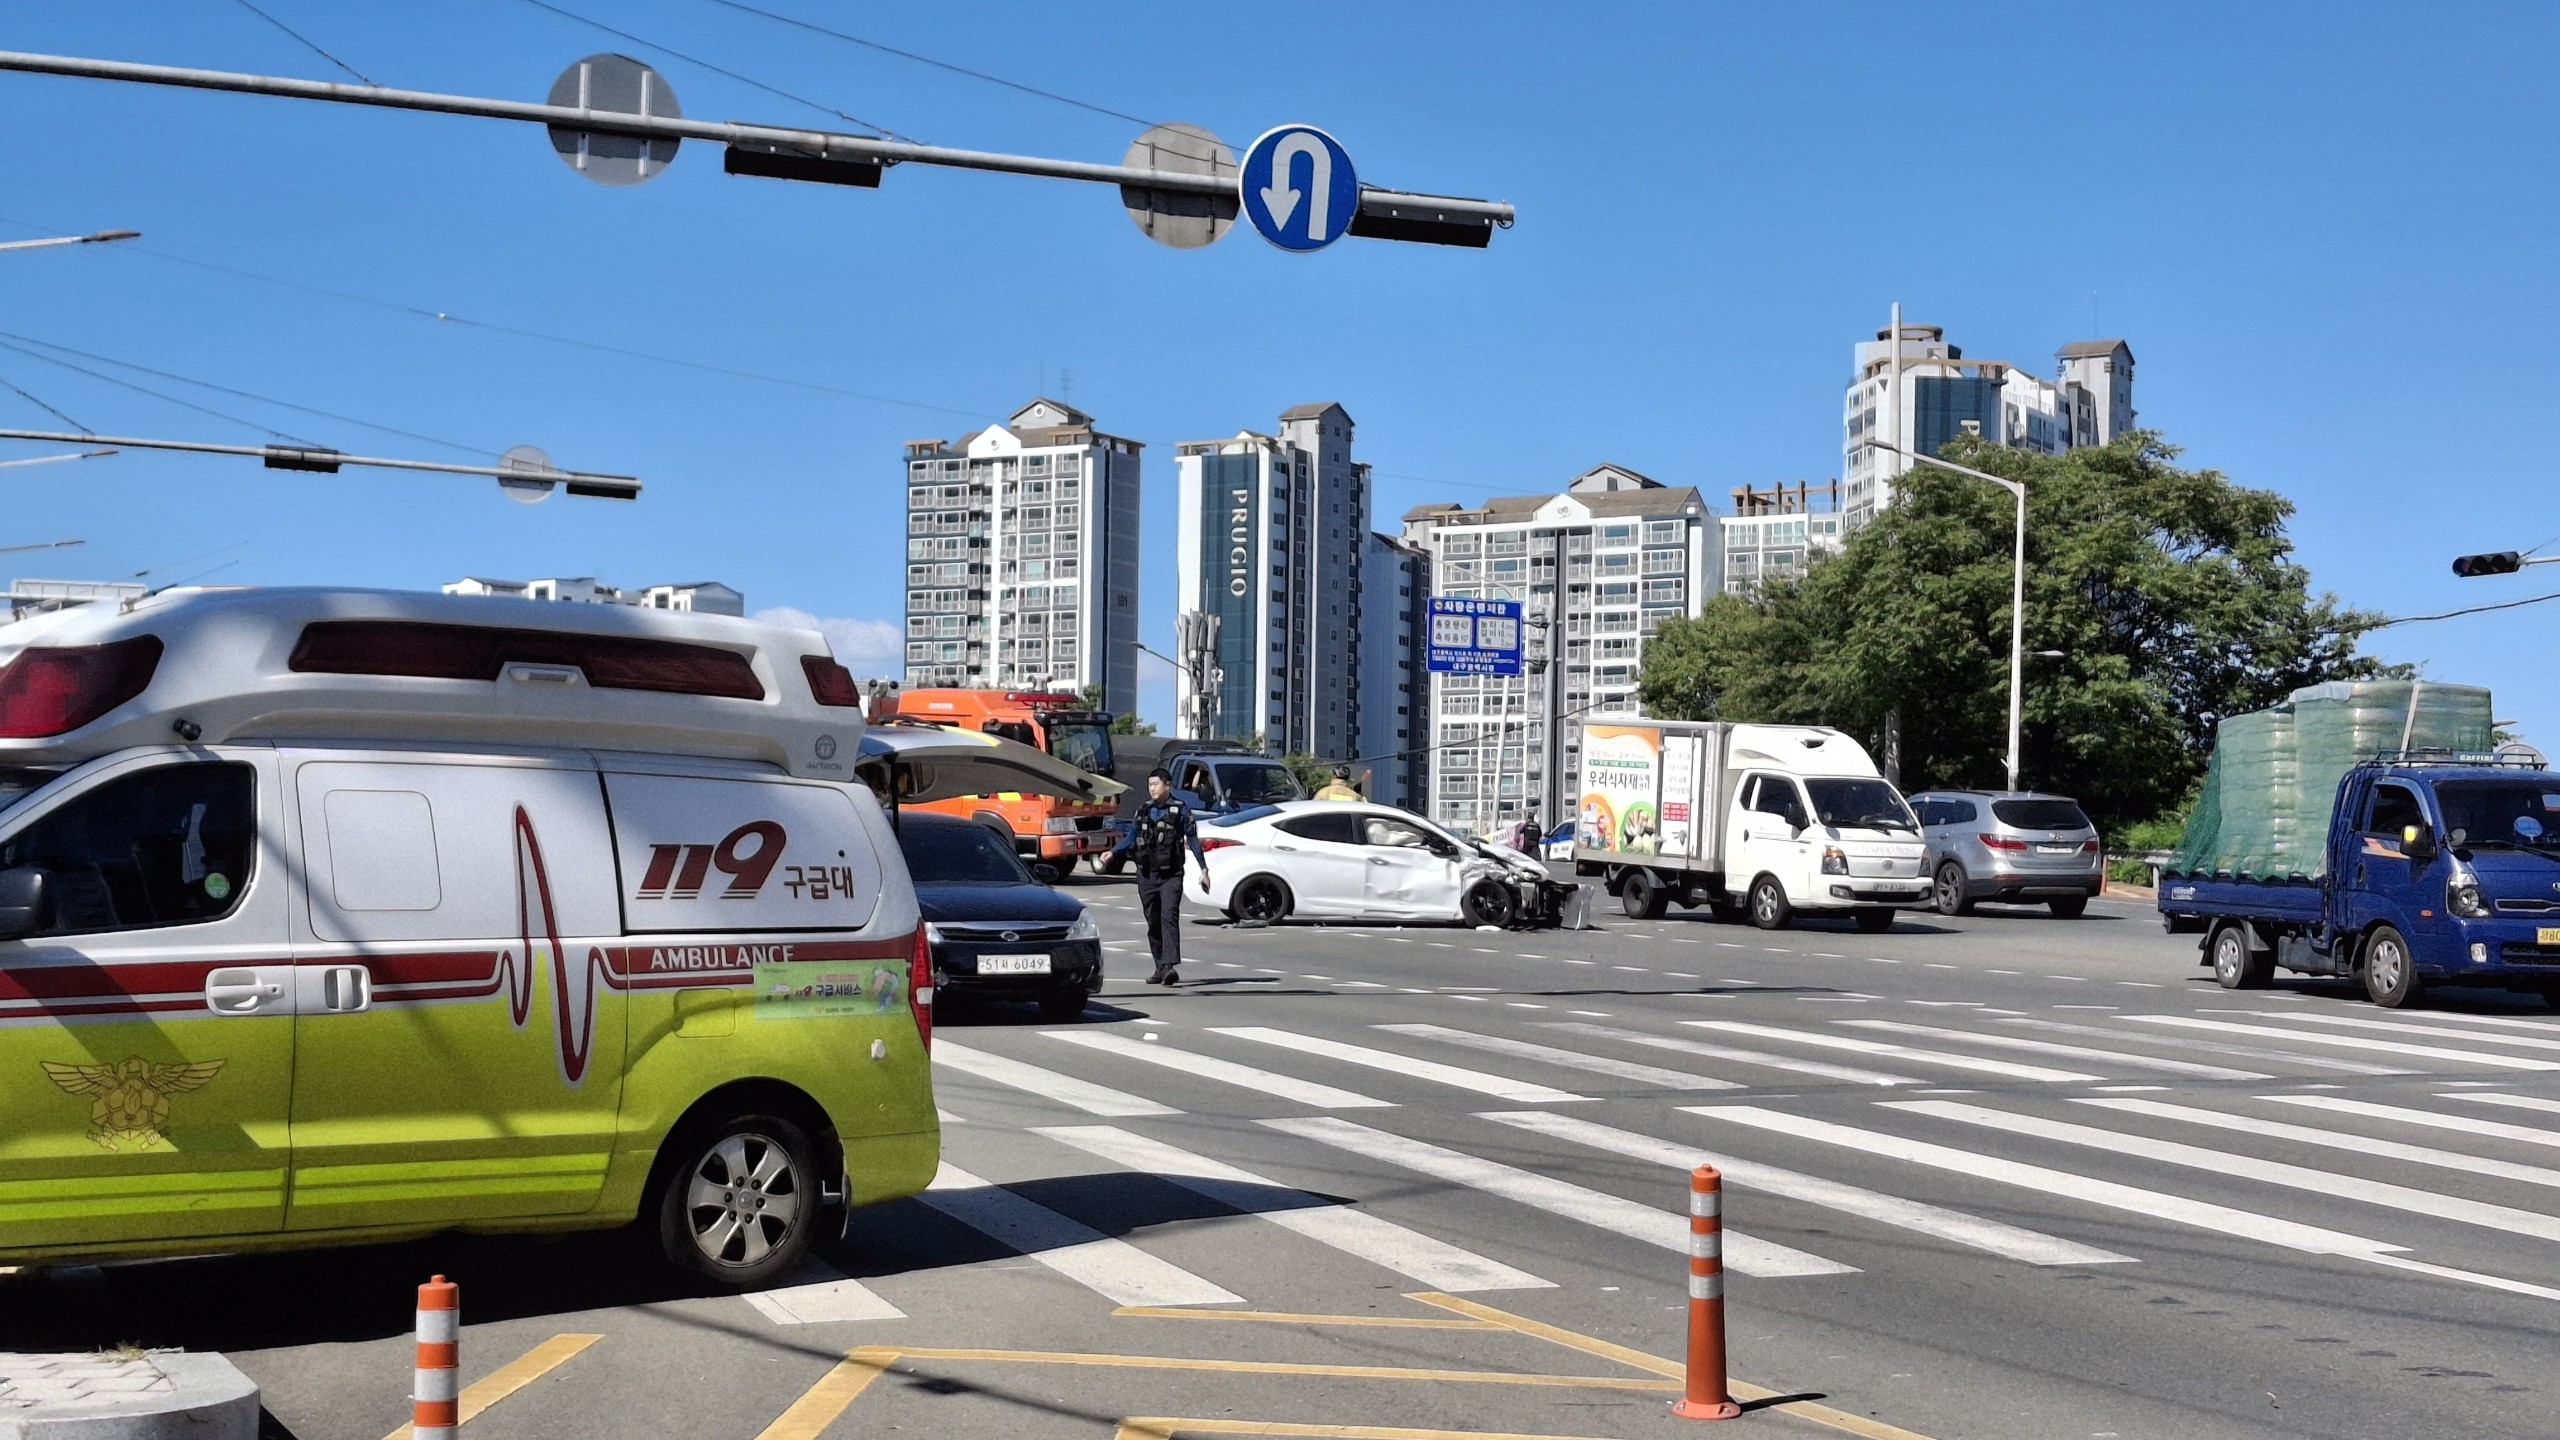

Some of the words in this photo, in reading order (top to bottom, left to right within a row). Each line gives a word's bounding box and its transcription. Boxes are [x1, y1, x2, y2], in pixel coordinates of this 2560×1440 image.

[1230, 489, 1248, 597] PRUGIO
[1589, 769, 1638, 790] 우리식자재
[635, 820, 787, 900] 119
[783, 865, 855, 900] 구급대
[650, 944, 795, 970] AMBULANCE
[1013, 957, 1044, 971] 6049
